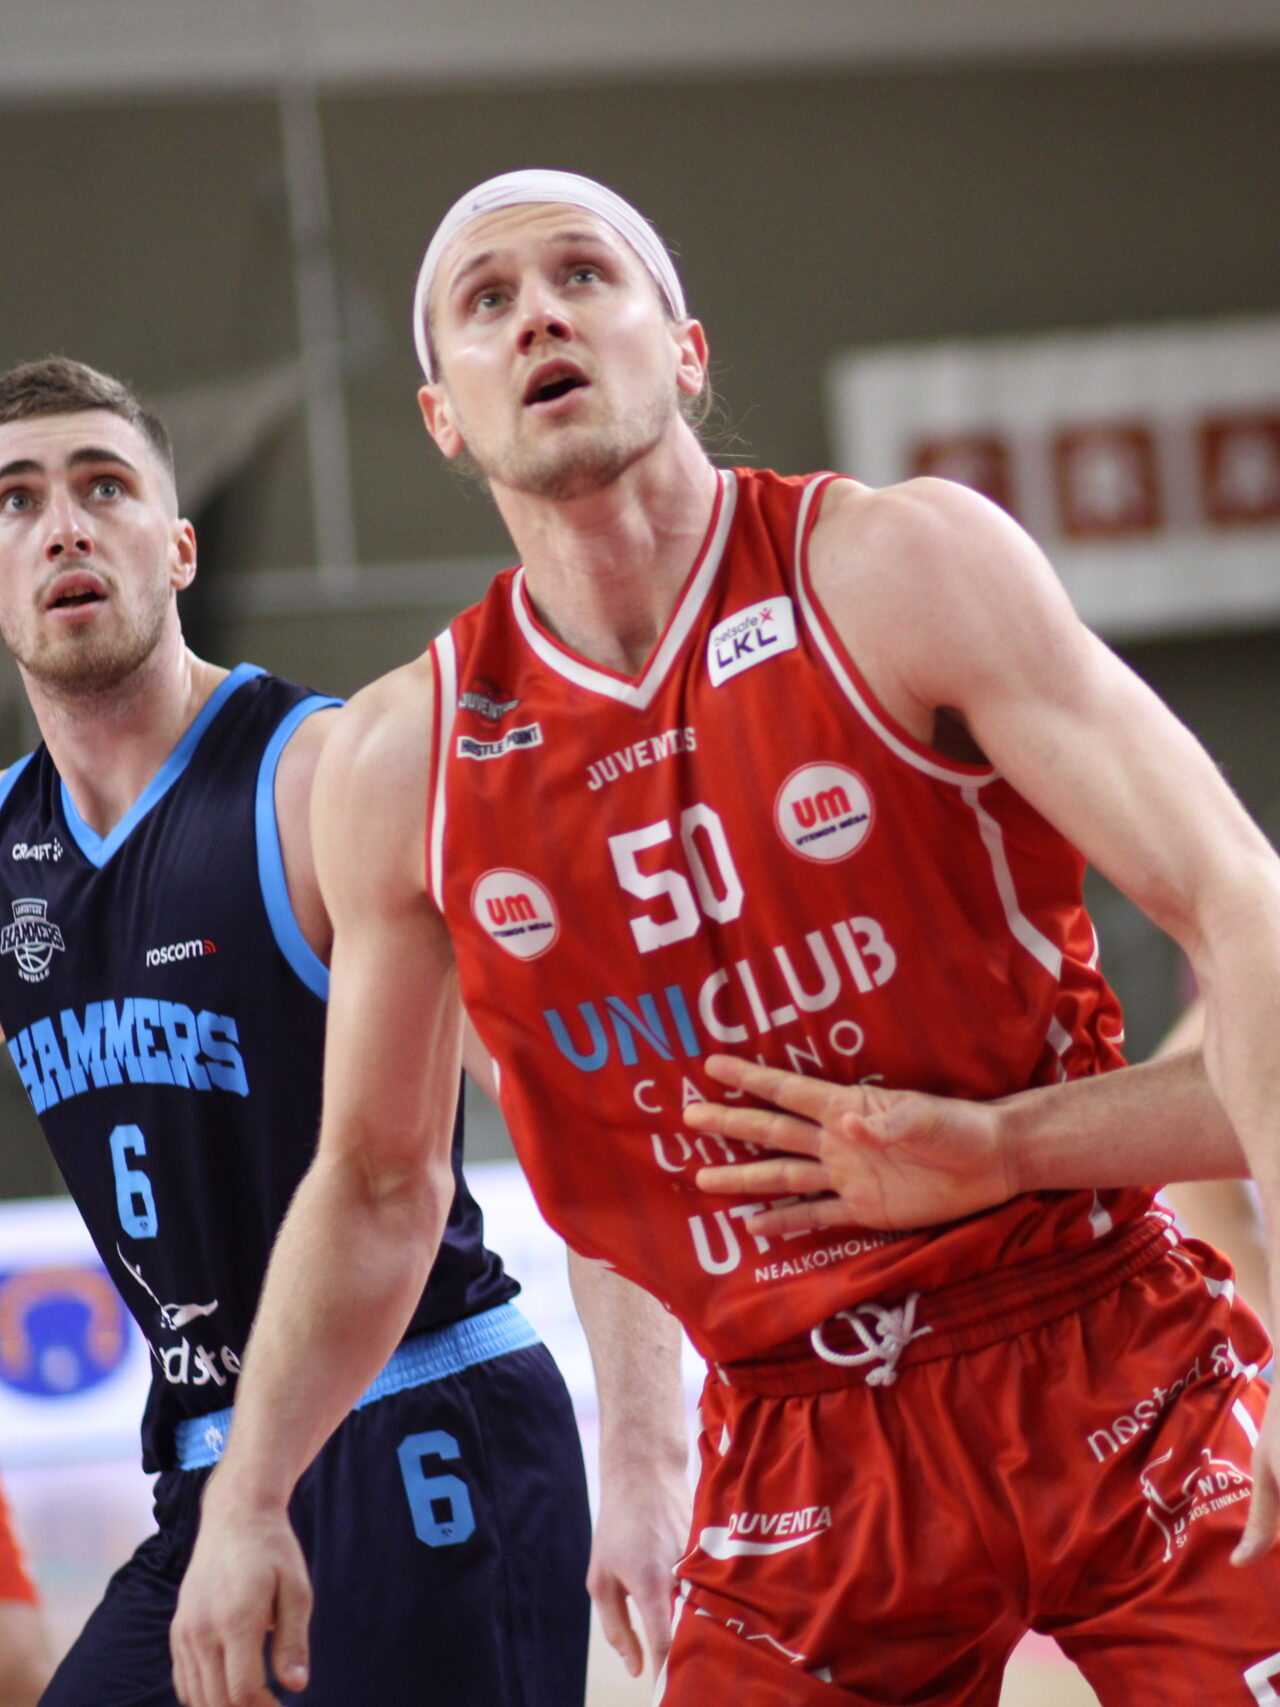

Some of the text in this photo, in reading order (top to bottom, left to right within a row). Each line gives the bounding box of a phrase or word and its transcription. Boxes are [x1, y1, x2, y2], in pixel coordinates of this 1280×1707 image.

[716, 627, 778, 669] LKL
[12, 842, 52, 861] CRAFT
[608, 803, 744, 954] 50
[2, 921, 63, 949] HAMMERS
[146, 938, 203, 968] roscom
[543, 916, 898, 1073] UNICLUB
[7, 997, 250, 1116] HAMMERS
[633, 1020, 864, 1113] CANO
[108, 1124, 158, 1239] 6
[397, 1430, 477, 1548] 6
